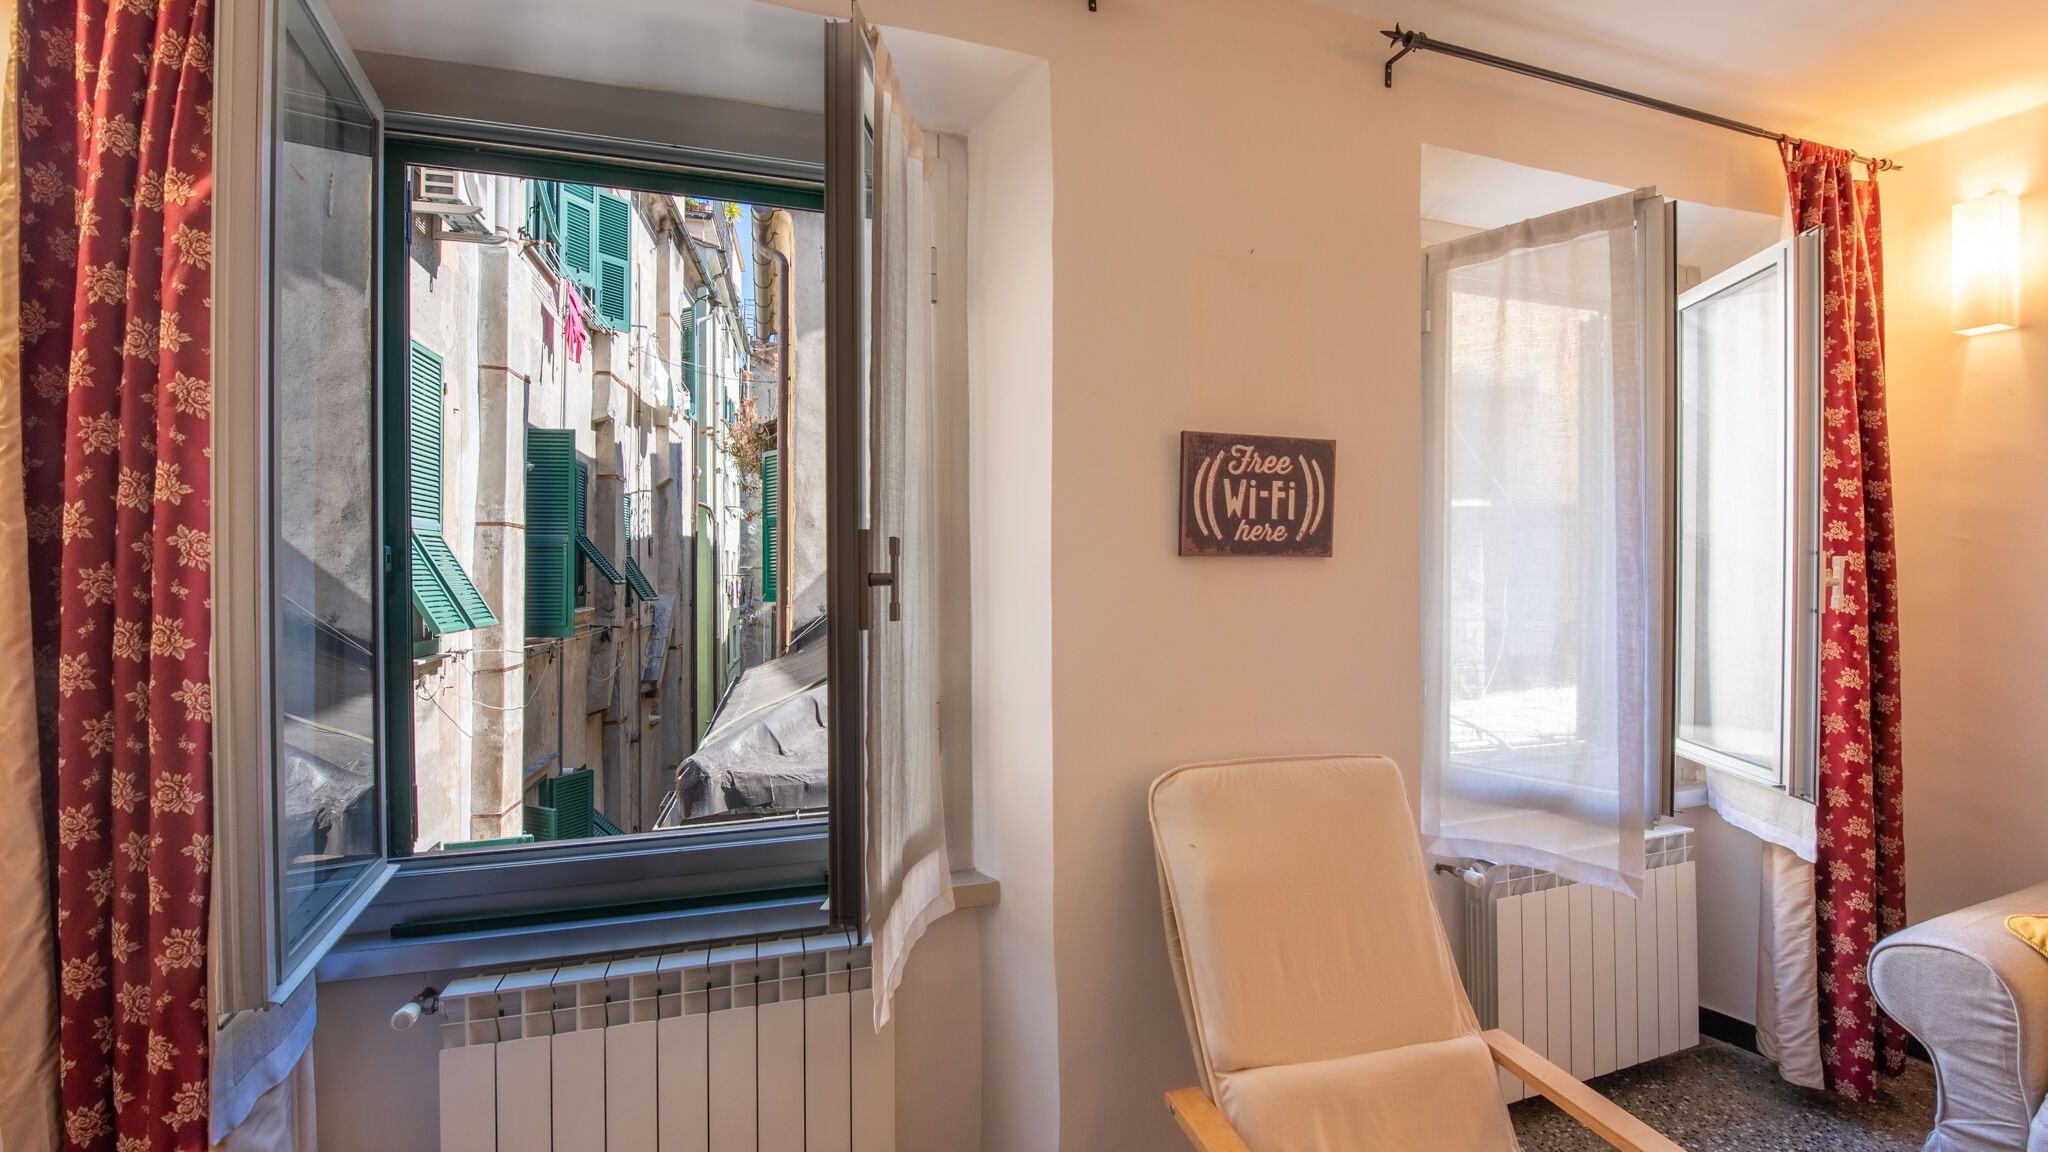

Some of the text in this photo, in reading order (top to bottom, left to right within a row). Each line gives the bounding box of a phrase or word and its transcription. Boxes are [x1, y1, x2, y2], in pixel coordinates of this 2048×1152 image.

[1228, 444, 1293, 475] Free
[1223, 478, 1296, 520] Wi-Fi
[1234, 519, 1288, 542] here
